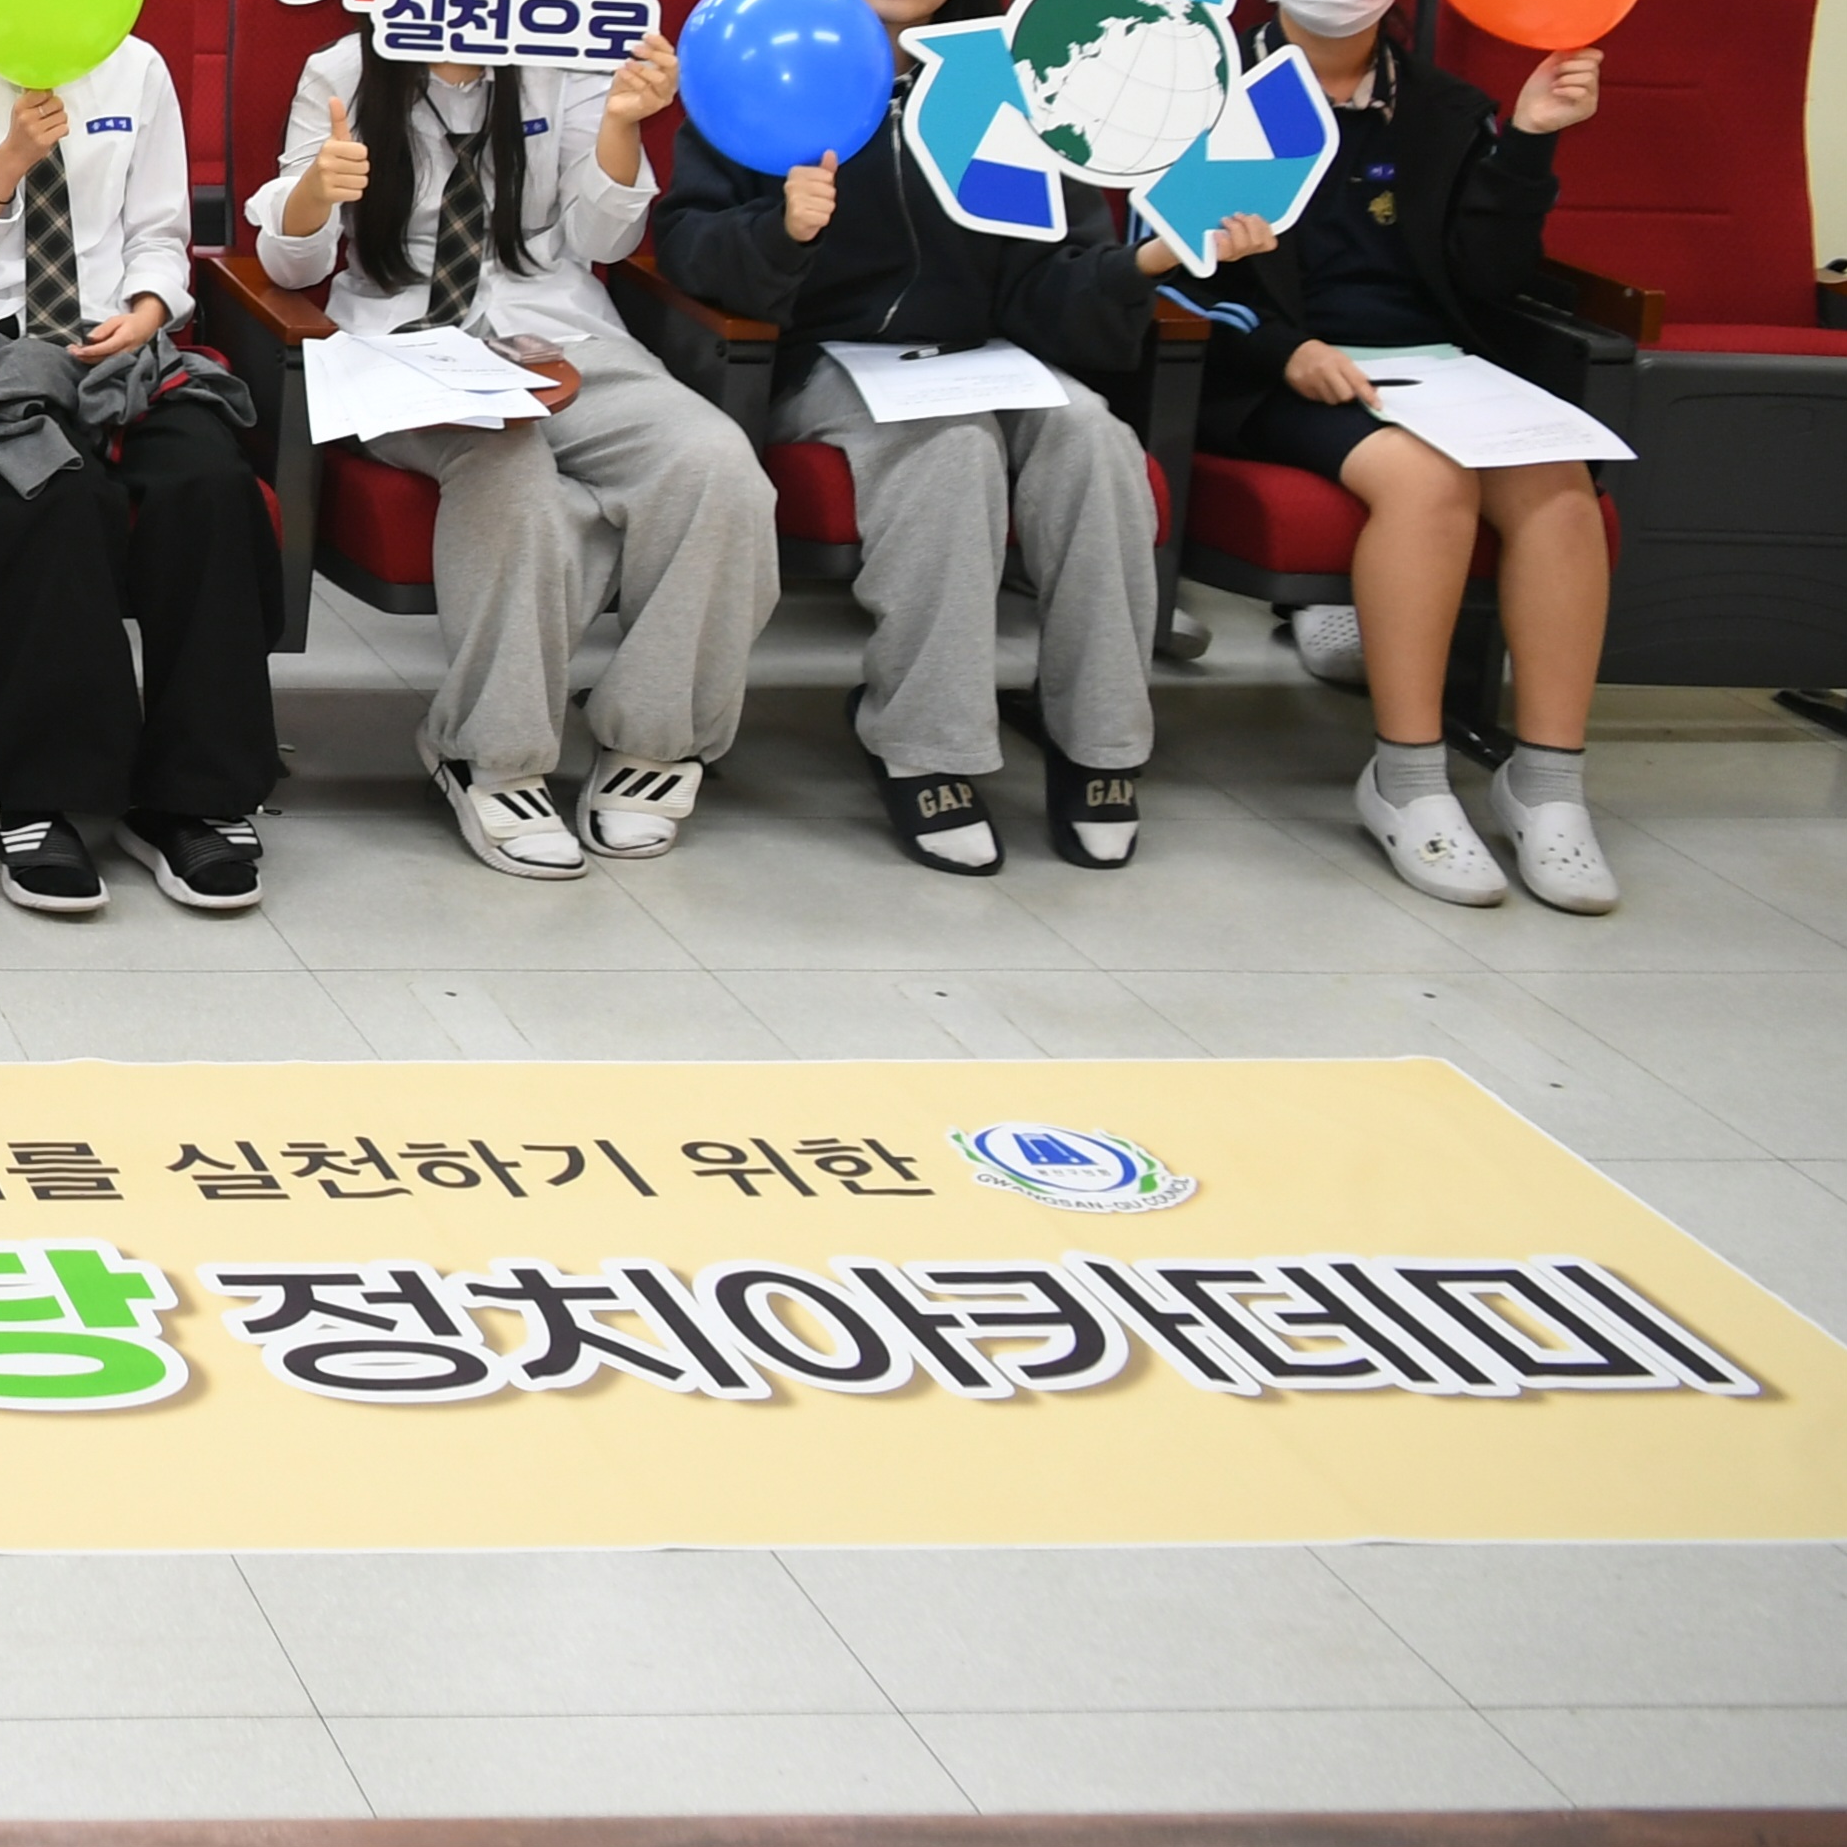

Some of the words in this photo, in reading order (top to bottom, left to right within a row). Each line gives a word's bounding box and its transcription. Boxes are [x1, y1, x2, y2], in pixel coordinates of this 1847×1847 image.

[916, 781, 974, 819] GAP
[165, 1135, 658, 1202] 실천하기
[678, 1136, 936, 1199] 위한
[218, 1261, 1743, 1391] 정치아카데미
